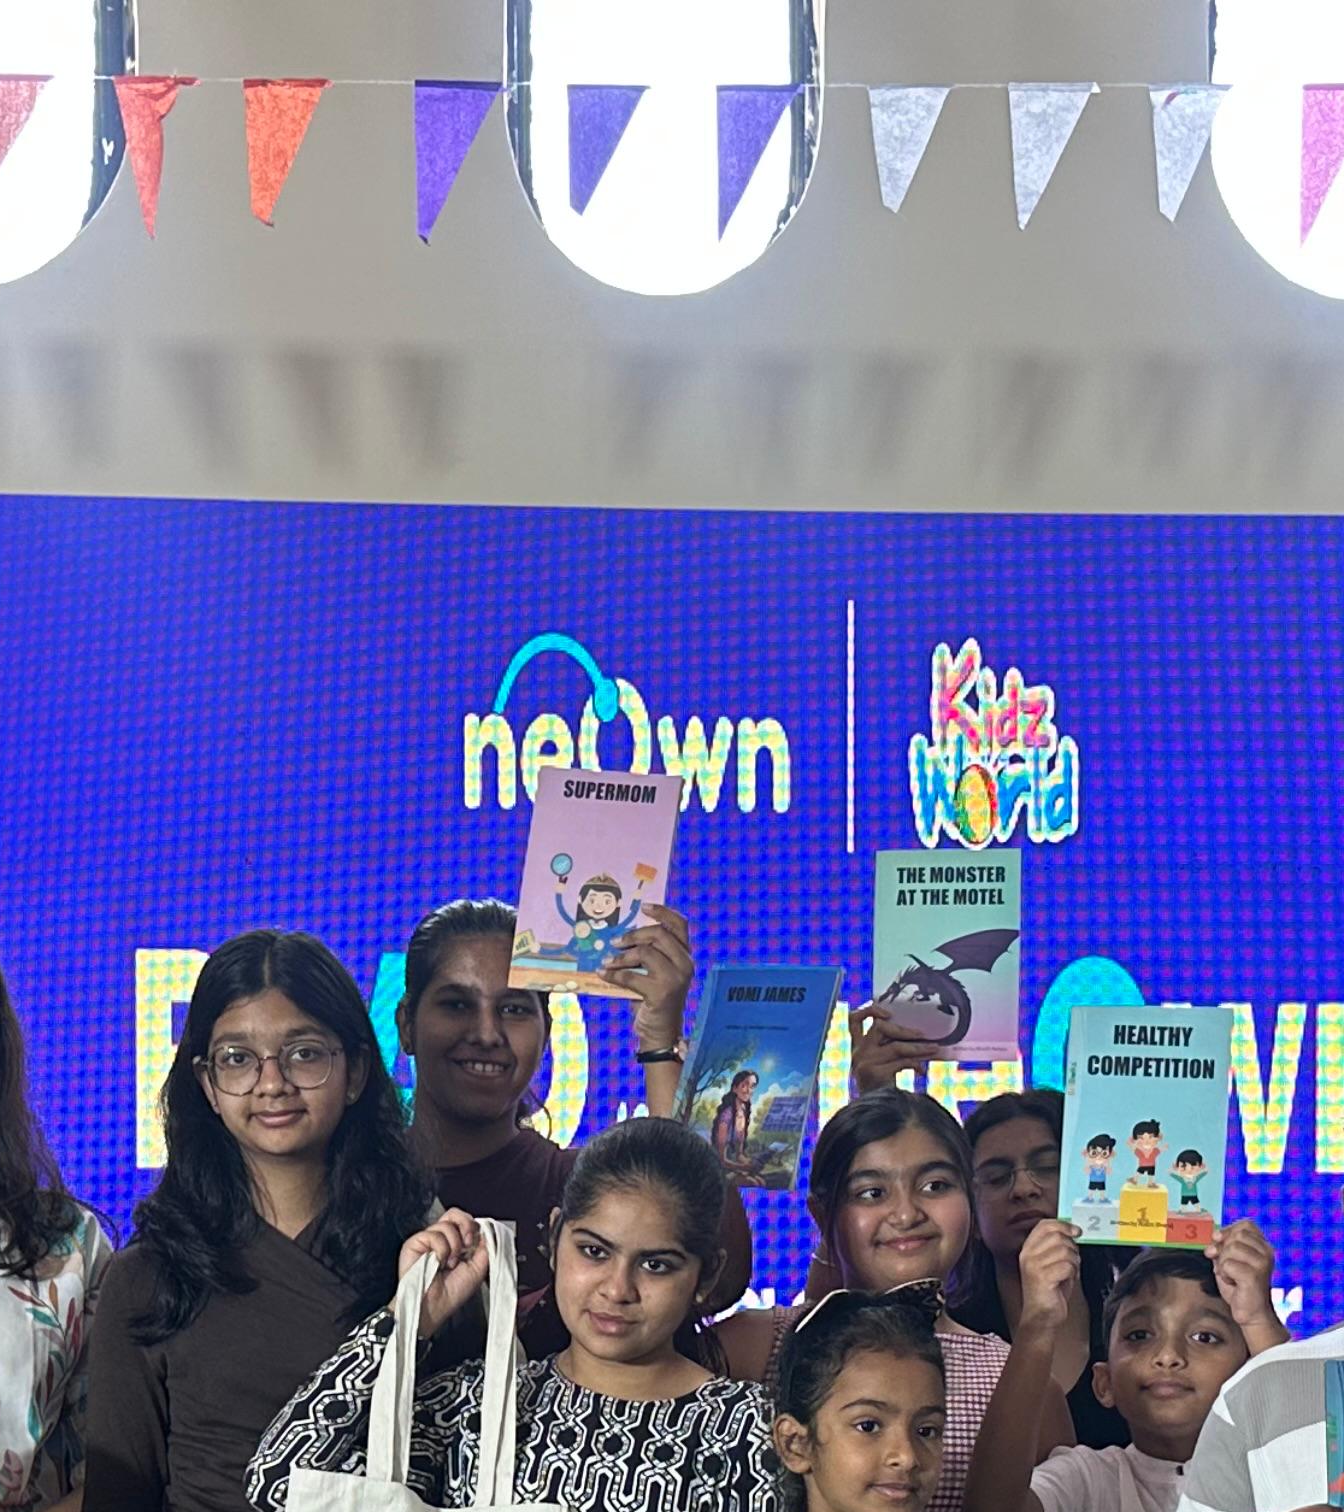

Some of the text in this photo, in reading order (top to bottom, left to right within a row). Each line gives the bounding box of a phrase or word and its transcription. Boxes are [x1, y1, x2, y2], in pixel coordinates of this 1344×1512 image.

[930, 638, 1058, 748] Kidz
[563, 779, 657, 804] SUPERMOM
[896, 866, 1006, 884] THE MONSTER
[896, 888, 1005, 906] AT THE MOTEL
[763, 986, 807, 1004] JAMES
[1113, 1024, 1194, 1047] HEALTHY
[1087, 1055, 1216, 1080] COMPETITION
[1087, 1216, 1101, 1232] 2
[1184, 1223, 1199, 1240] 3
